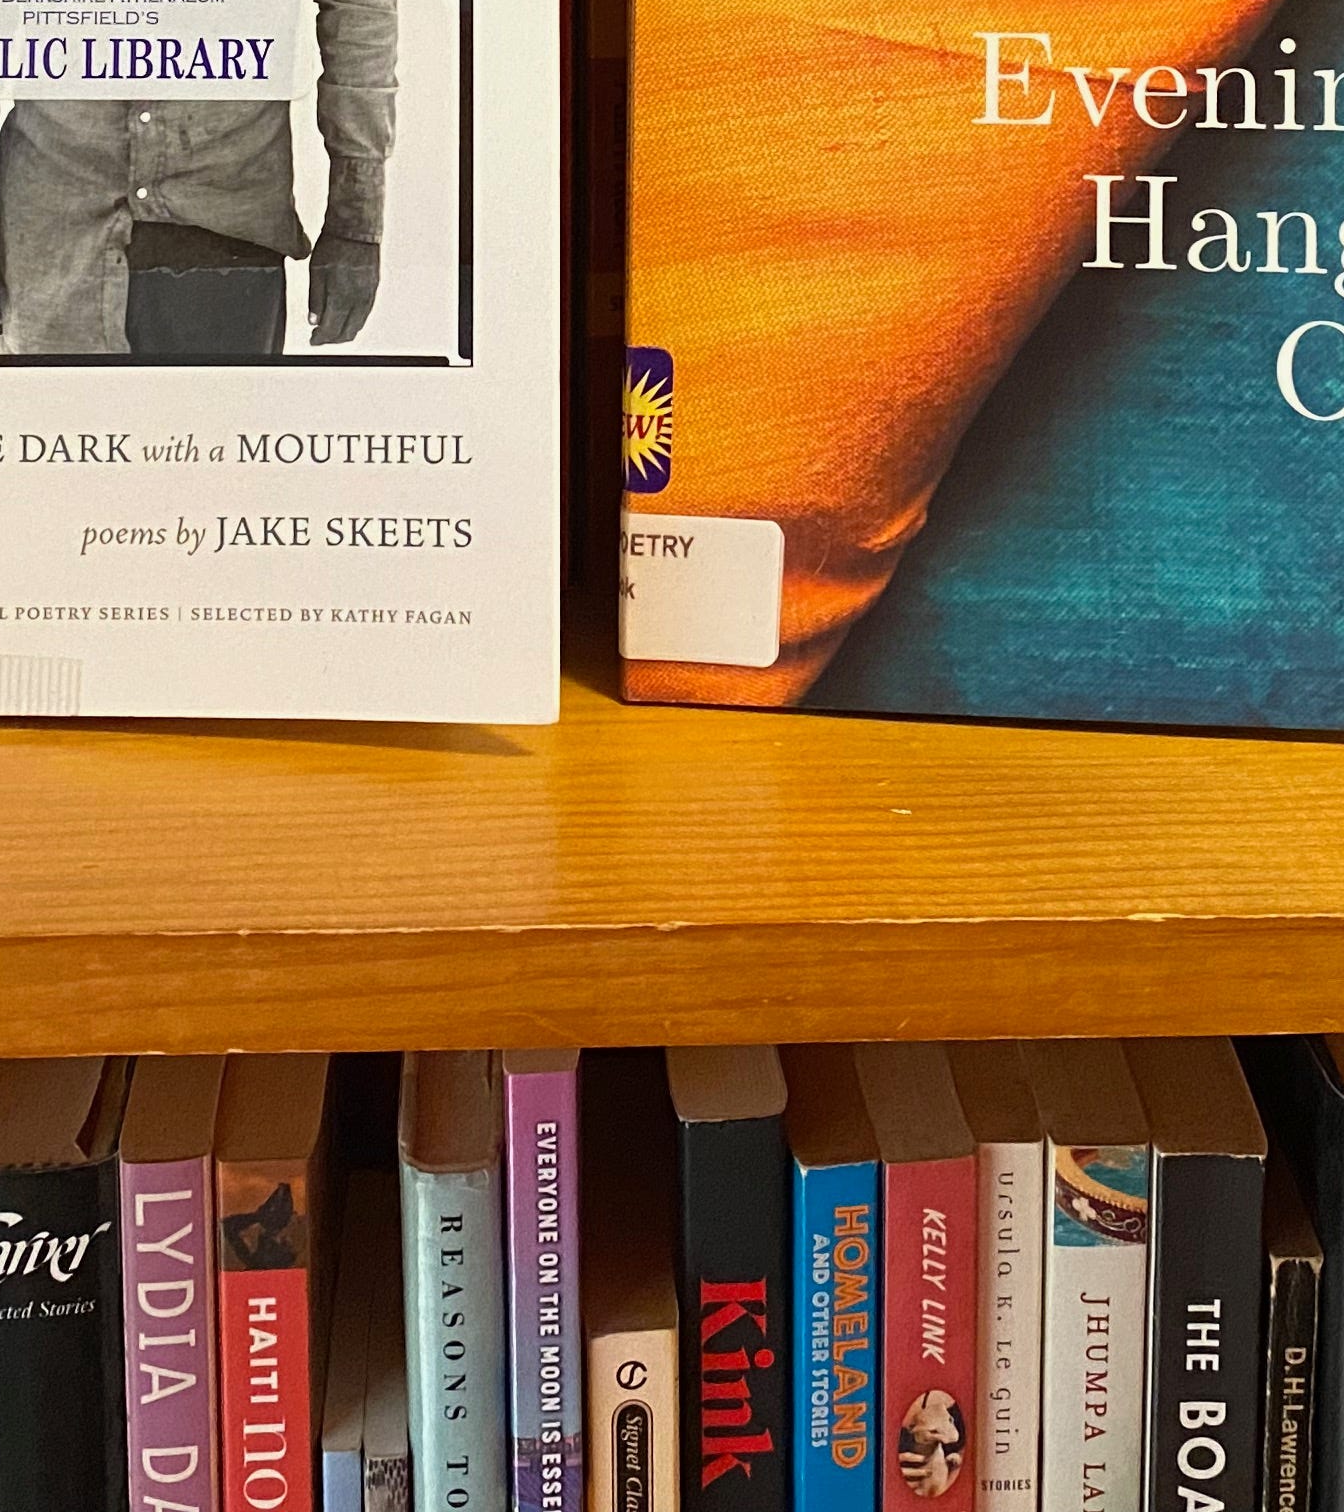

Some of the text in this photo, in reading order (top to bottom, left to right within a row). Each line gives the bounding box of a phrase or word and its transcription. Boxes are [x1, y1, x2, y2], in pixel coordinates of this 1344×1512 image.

[21, 10, 160, 25] PITTSFIELD'S
[81, 37, 274, 81] LIBRARY
[20, 433, 132, 465] DARK
[142, 433, 202, 465] with
[209, 445, 226, 464] a
[236, 433, 473, 466] MOUTHFUL
[80, 522, 167, 555] poems
[176, 518, 206, 555] by
[214, 516, 312, 550] JAKE
[326, 517, 474, 548] SKEETS
[14, 607, 92, 622] POETRY
[98, 607, 171, 622] SERIES
[190, 608, 294, 623] SELECTED
[299, 609, 325, 623] BY
[330, 608, 399, 623] KATHY
[404, 609, 473, 625] FAGAN
[39, 1297, 95, 1318] Stories
[134, 1190, 197, 1405] LYDIA
[536, 1122, 562, 1444] EVERYONE ON THE MOON IS
[921, 1207, 947, 1365] KELLY LINK
[248, 1297, 278, 1404] HAITI
[440, 1215, 470, 1509] REASONS TO
[811, 1234, 830, 1448] AND OTHER STORIES
[832, 1205, 869, 1470] HOMELAND
[1080, 1292, 1110, 1443] JHUMPA
[1186, 1299, 1221, 1372] THE
[700, 1277, 774, 1488] Kink
[621, 1416, 642, 1471] Signet
[981, 1478, 1032, 1492] STORIES
